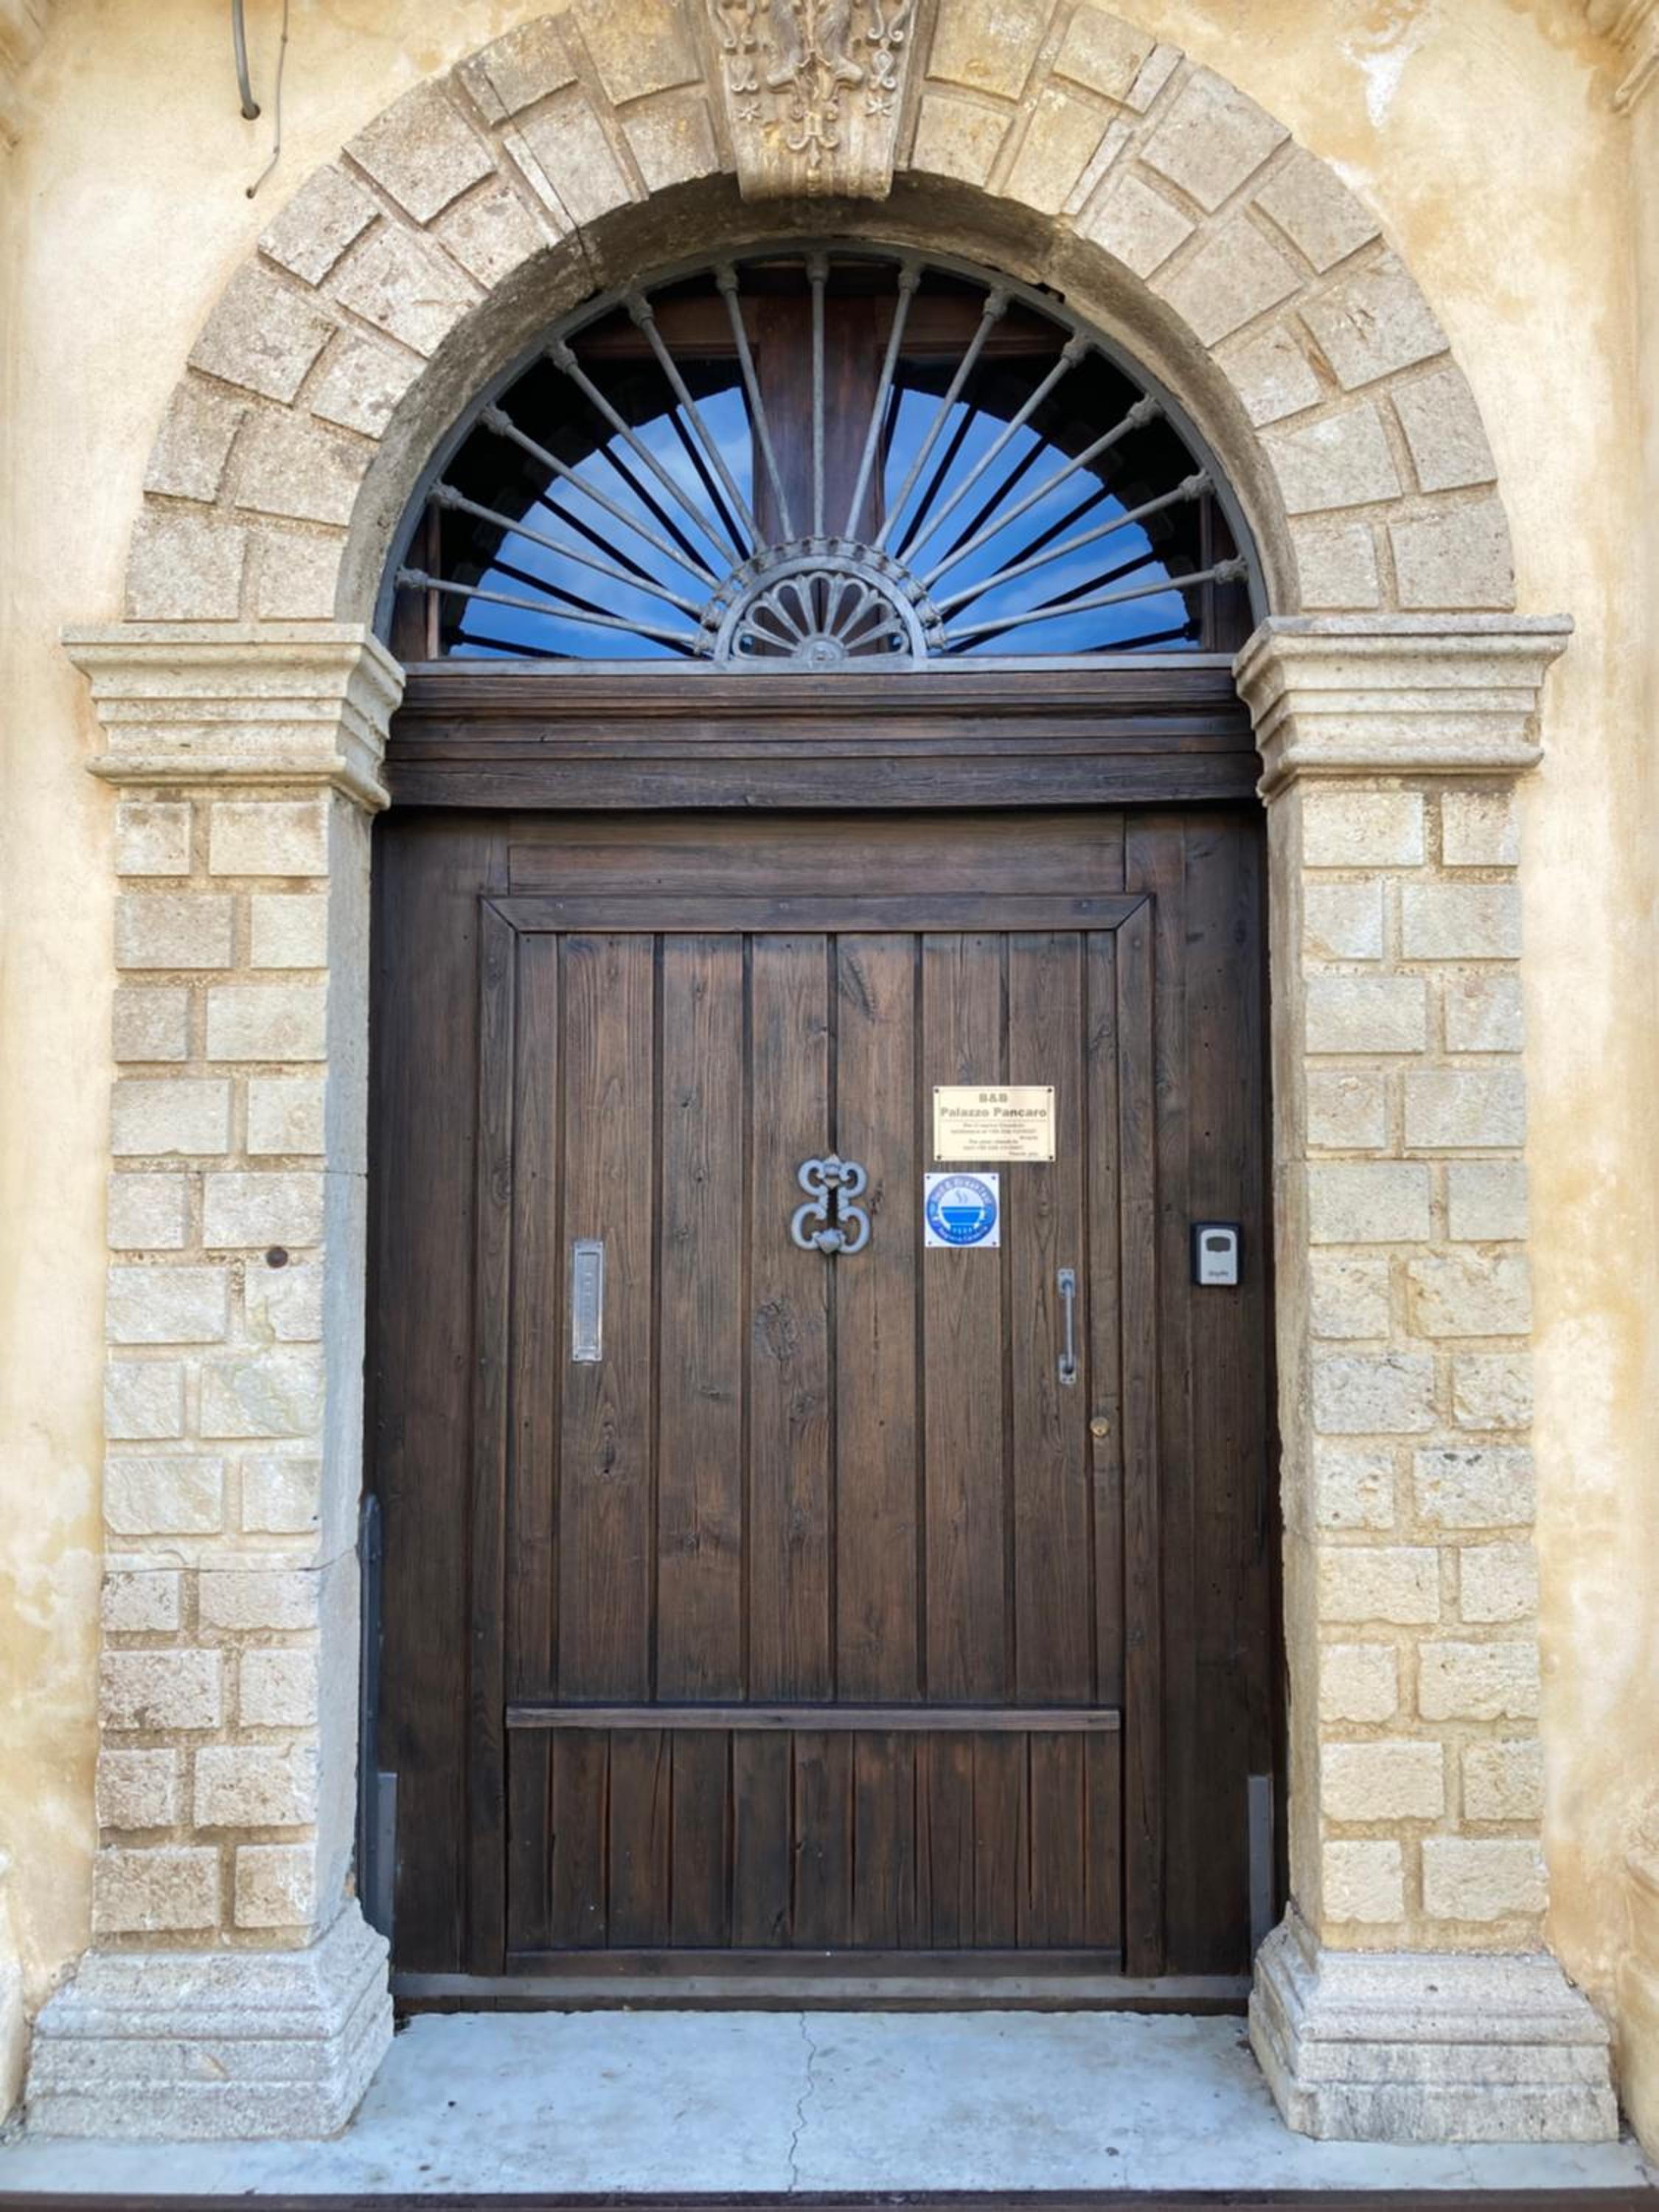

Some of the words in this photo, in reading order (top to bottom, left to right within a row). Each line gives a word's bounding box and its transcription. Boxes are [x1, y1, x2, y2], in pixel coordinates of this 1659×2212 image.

[979, 1093, 1008, 1103] B&B
[941, 1107, 990, 1117] Palazzo
[993, 1107, 1048, 1117] Pancaro
